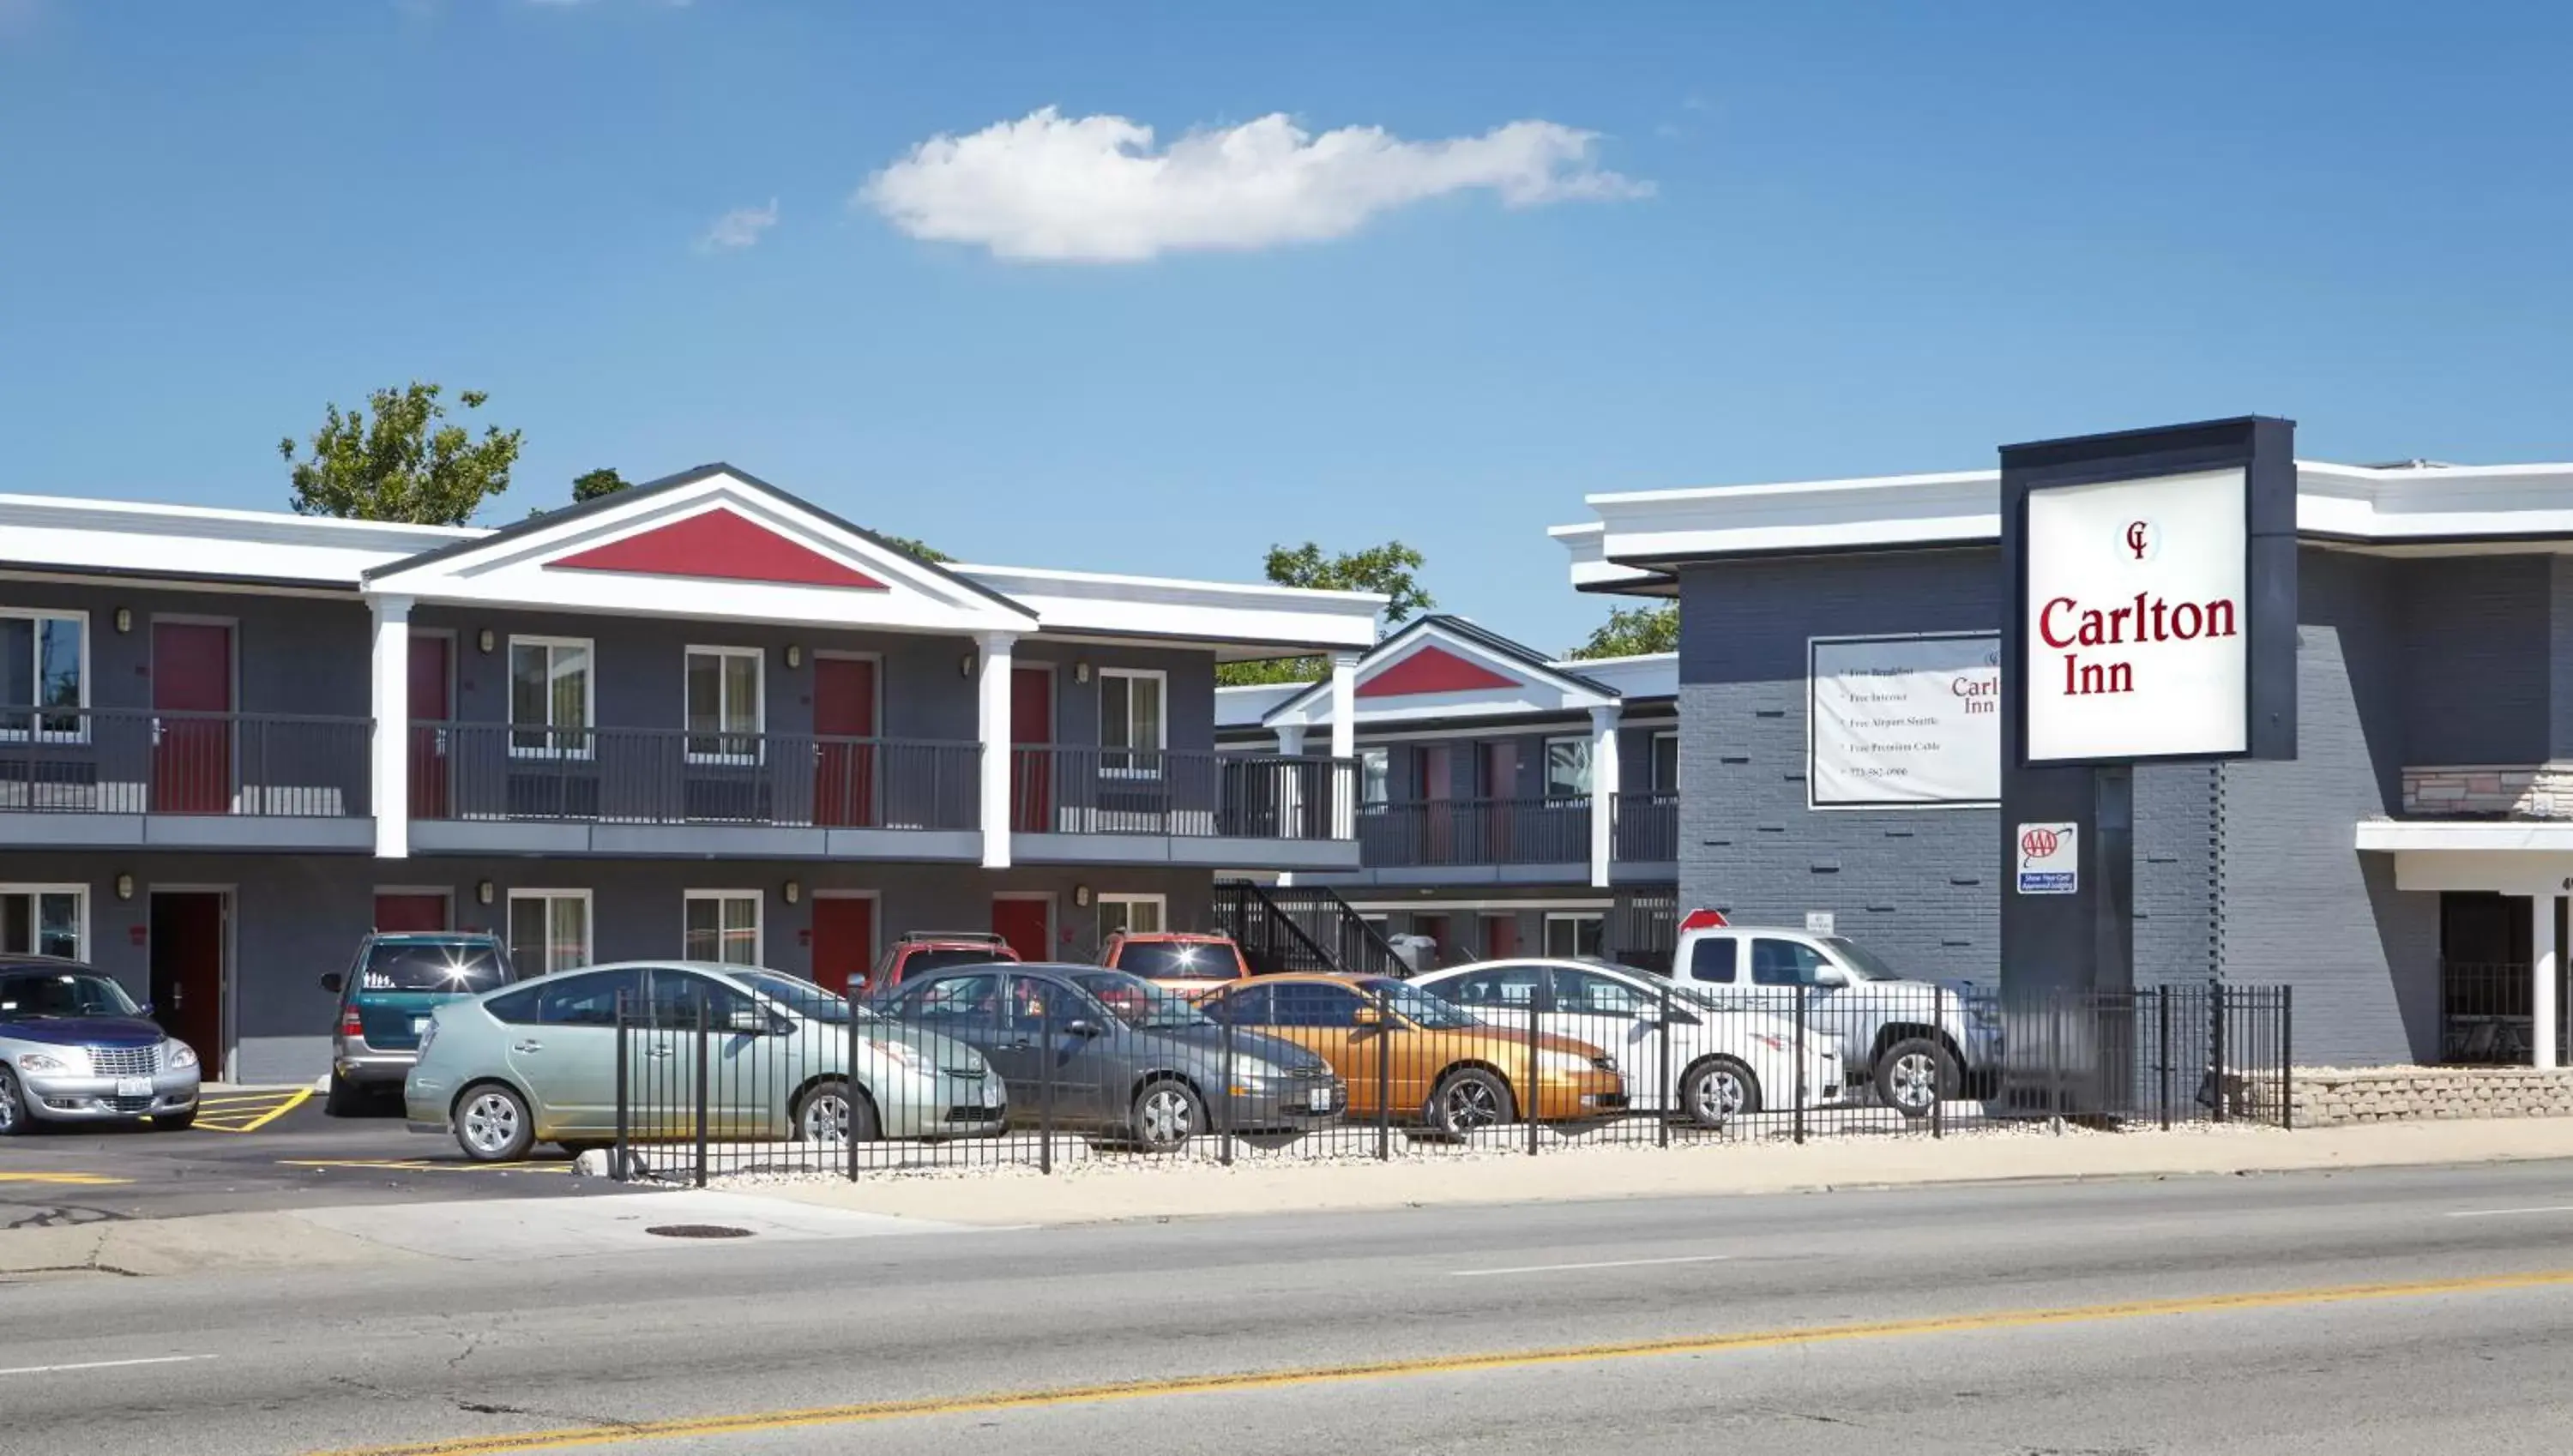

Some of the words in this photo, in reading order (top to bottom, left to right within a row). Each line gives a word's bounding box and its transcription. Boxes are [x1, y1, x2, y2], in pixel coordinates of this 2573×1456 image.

[2040, 592, 2237, 648] Carlton
[1850, 668, 1868, 677] Free
[2064, 653, 2134, 695] Inn
[1952, 677, 1998, 697] Carl
[1850, 693, 1868, 702] Free
[1871, 693, 1907, 701] Internet
[1965, 697, 1994, 713] Inn
[1850, 719, 1868, 727] Free
[1871, 719, 1904, 729] Airport
[1907, 717, 1939, 726] Shuttle
[1850, 743, 1868, 752] Free
[1871, 743, 1912, 752] Premium
[1913, 742, 1939, 751] Cable
[2025, 830, 2055, 855] AAA
